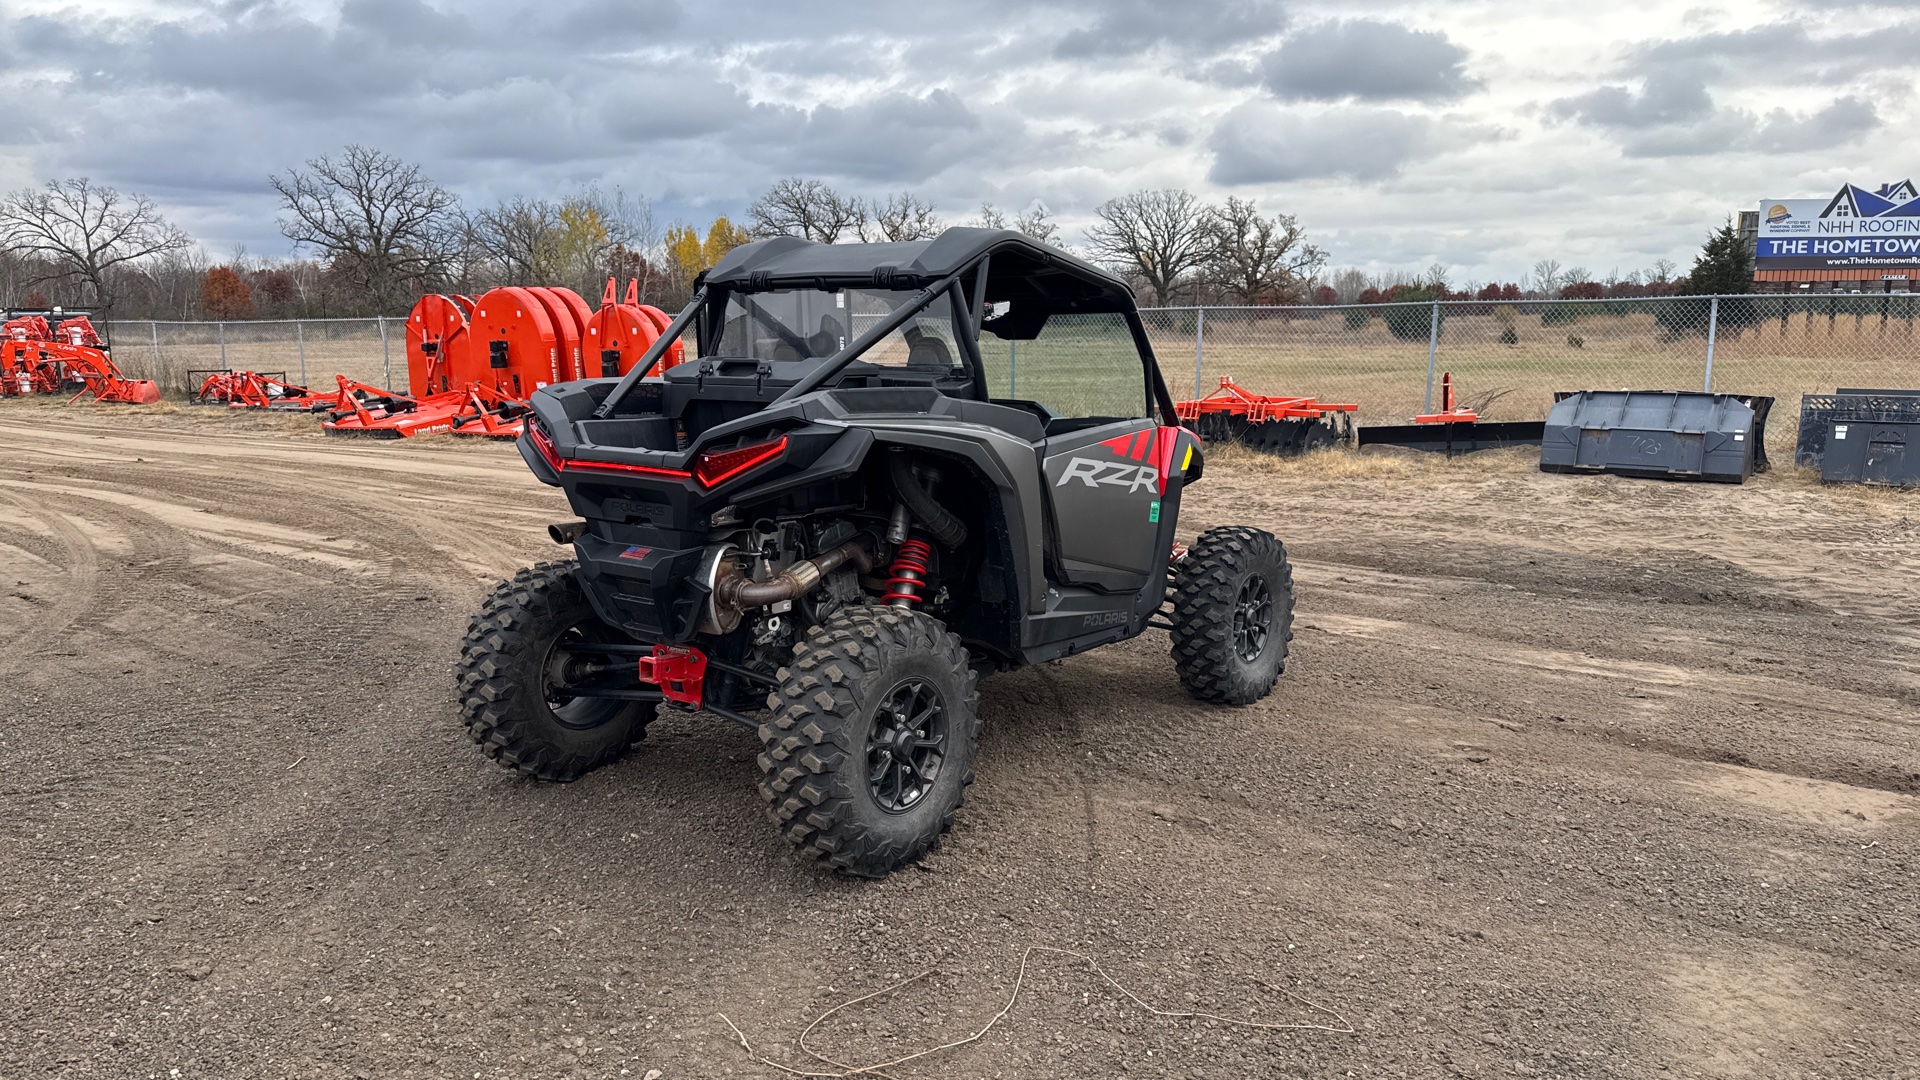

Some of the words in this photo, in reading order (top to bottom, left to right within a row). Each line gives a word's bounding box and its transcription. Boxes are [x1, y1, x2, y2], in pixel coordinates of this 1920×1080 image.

[1818, 220, 1853, 233] NHH
[1769, 240, 1808, 254] THE
[1813, 239, 1920, 254] HOMETOW
[1056, 457, 1158, 494] RZR
[611, 501, 665, 516] POLARIS
[1082, 611, 1128, 627] POLARIS
